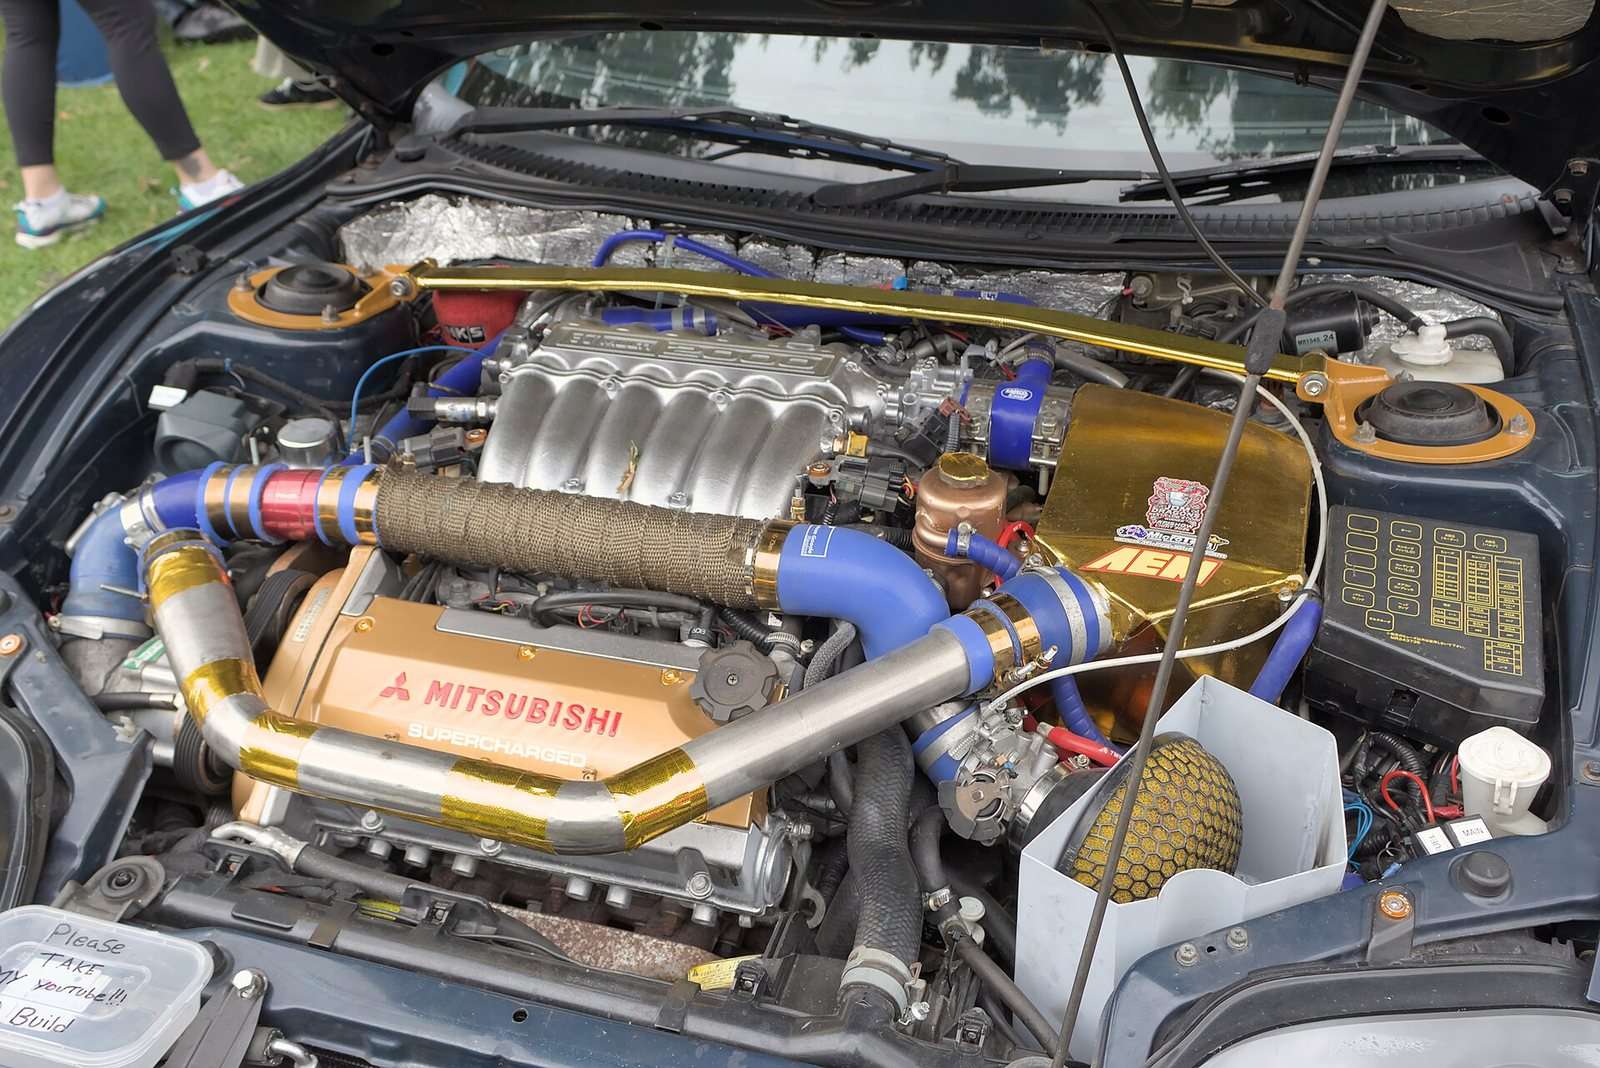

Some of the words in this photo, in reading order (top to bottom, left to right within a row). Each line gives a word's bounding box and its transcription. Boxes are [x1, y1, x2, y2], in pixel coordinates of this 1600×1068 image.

[424, 679, 623, 738] MITSUBISHI
[407, 722, 588, 769] SUPERCHARGED
[46, 922, 126, 956] Please
[40, 951, 105, 976] TAKE
[8, 1006, 76, 1034] Build
